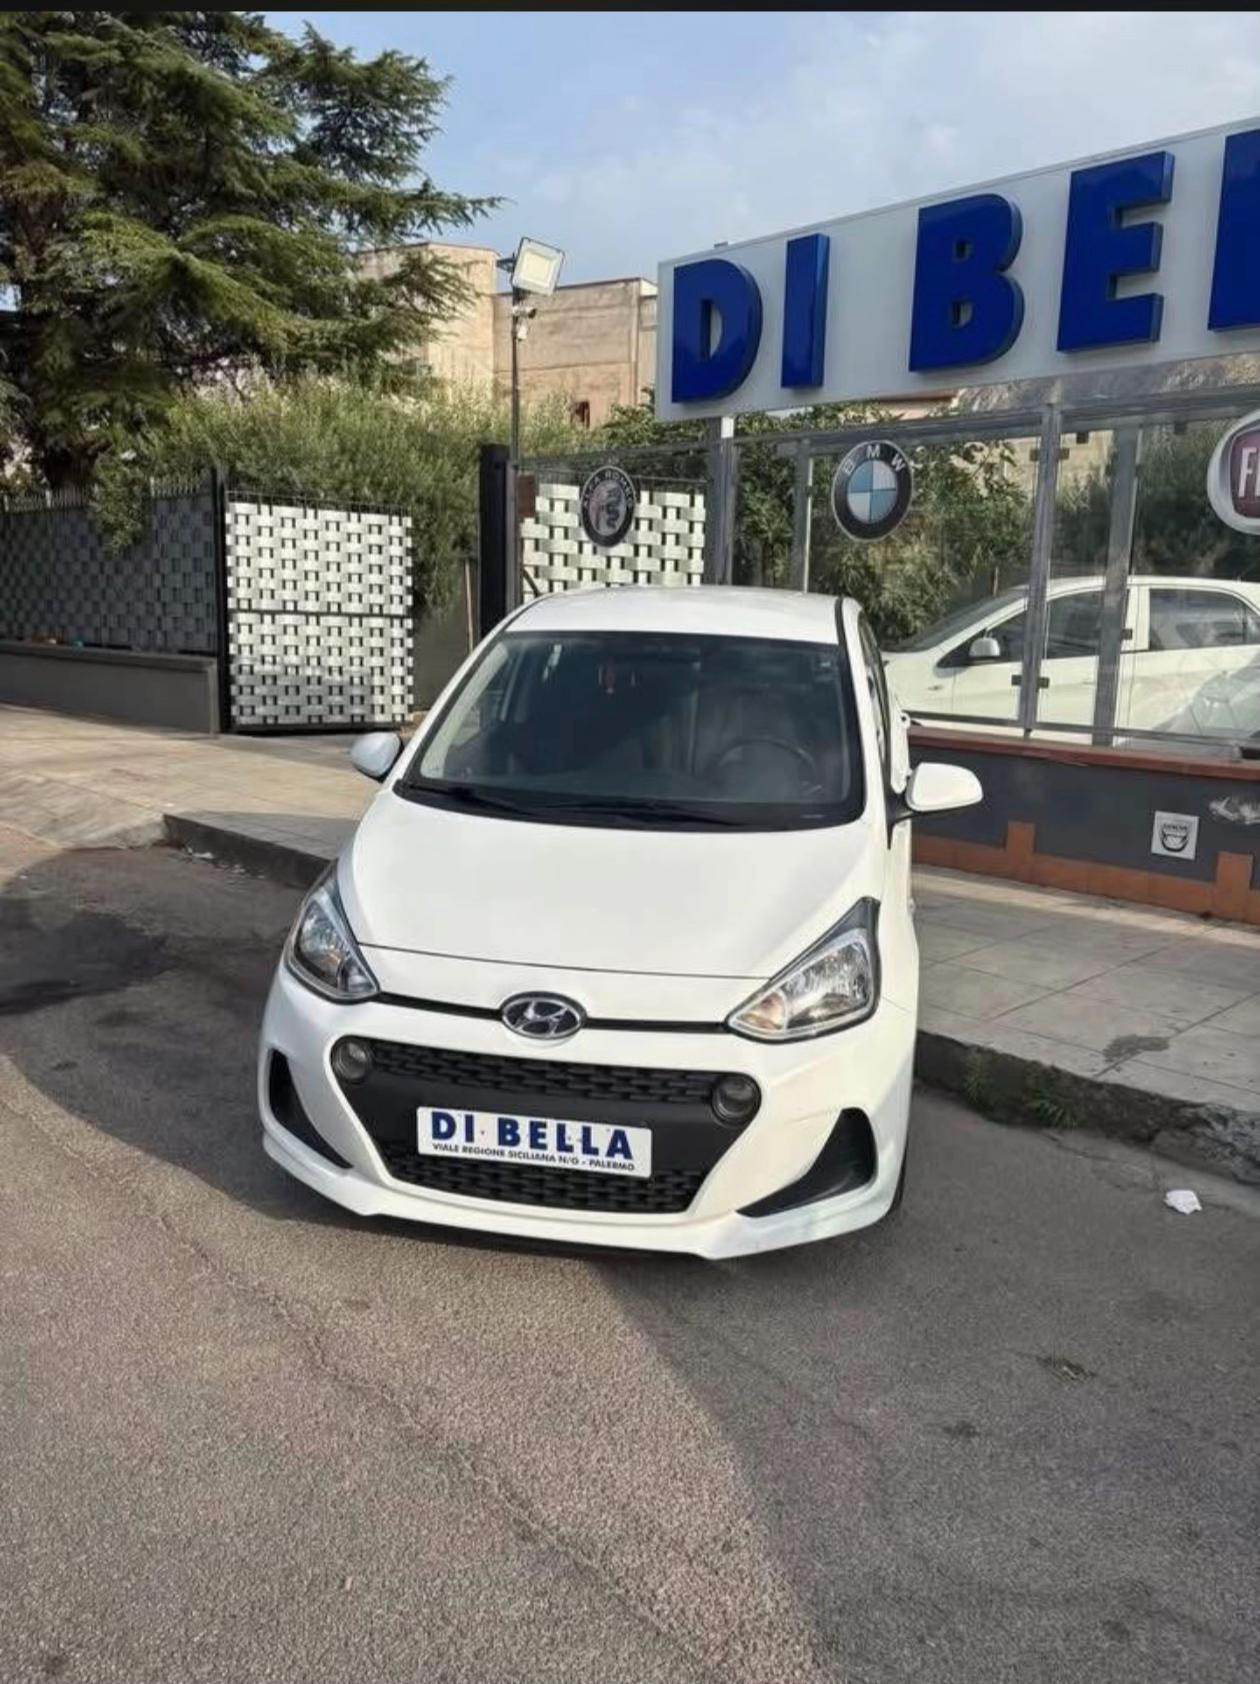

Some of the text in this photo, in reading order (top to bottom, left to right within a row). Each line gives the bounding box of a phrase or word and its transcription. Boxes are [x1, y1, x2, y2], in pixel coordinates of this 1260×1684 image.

[672, 232, 830, 404] DI
[843, 443, 906, 476] BMW
[431, 1111, 633, 1160] DI BELLA
[432, 1143, 459, 1153] VIALE
[462, 1146, 505, 1157] REGIONE
[507, 1150, 556, 1162] SICILIANA
[589, 1159, 635, 1171] PALERMO
